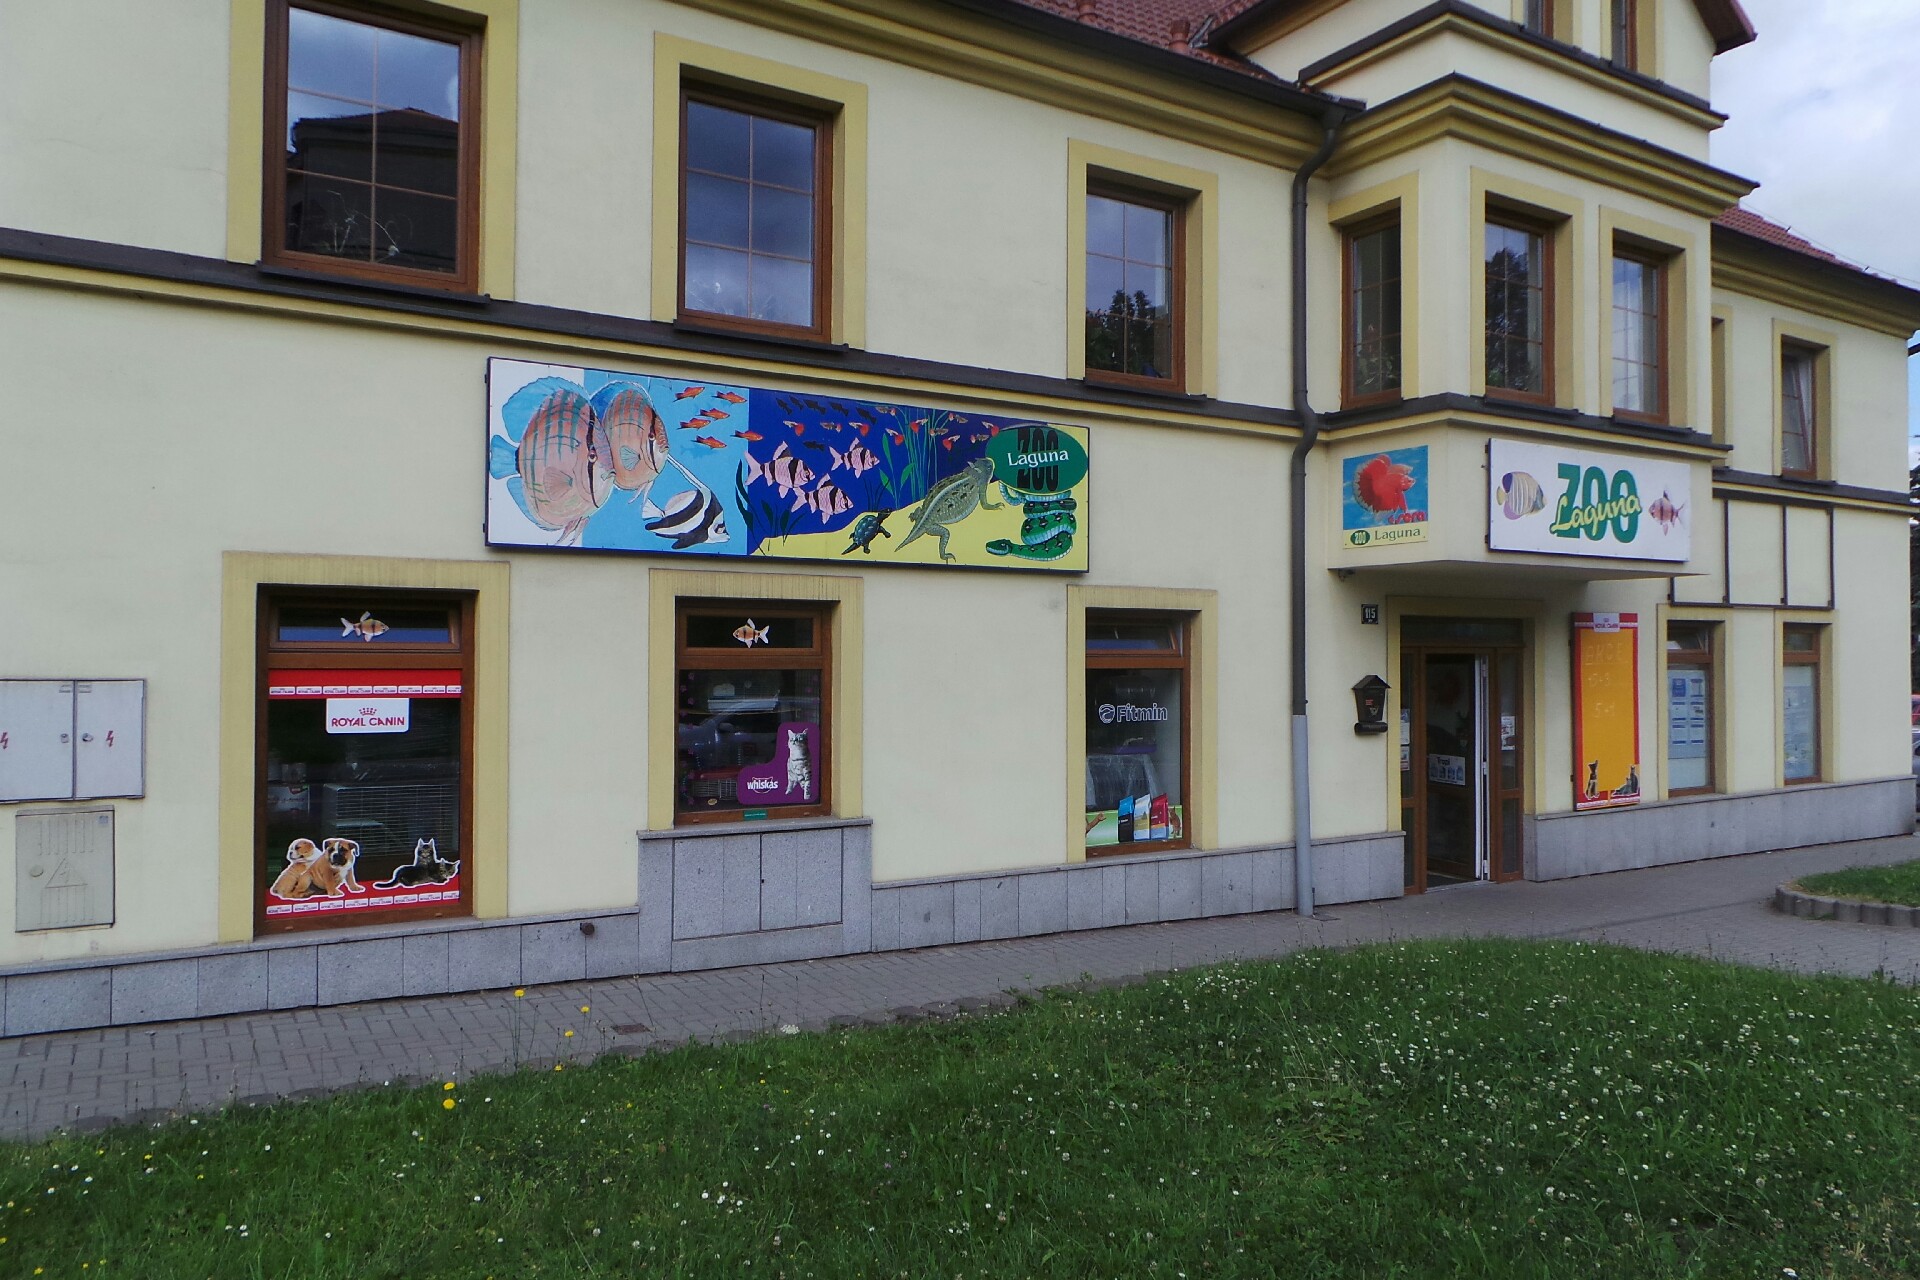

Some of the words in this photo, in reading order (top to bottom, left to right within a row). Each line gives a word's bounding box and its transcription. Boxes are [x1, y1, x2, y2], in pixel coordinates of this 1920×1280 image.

[1007, 450, 1069, 468] Laguna
[1017, 428, 1059, 491] ZOO
[1557, 463, 1639, 543] ZOO
[1549, 493, 1642, 536] Laguna
[1374, 528, 1421, 542] Laguna
[331, 717, 366, 727] ROYAL
[369, 717, 405, 726] CANIN
[1116, 702, 1168, 723] Fitmin
[746, 779, 779, 790] whiskas
